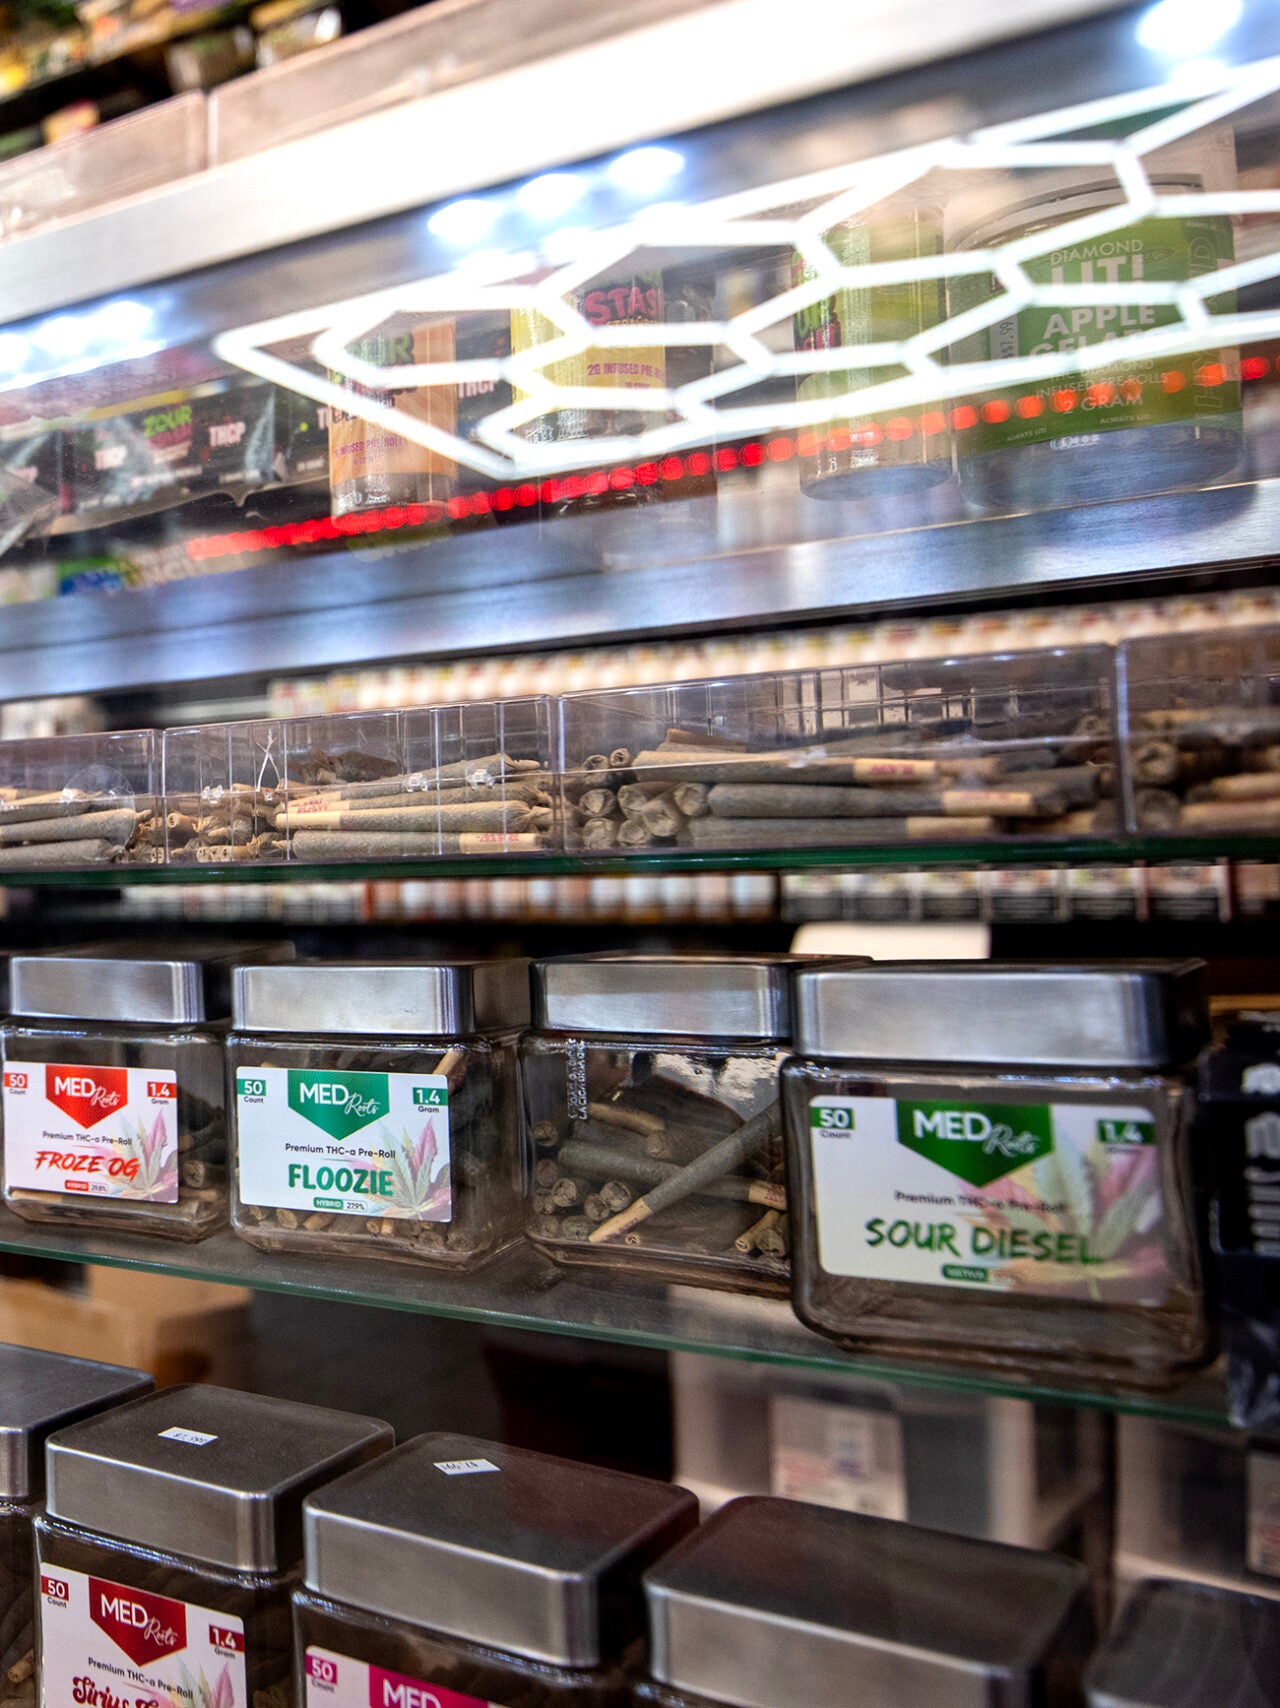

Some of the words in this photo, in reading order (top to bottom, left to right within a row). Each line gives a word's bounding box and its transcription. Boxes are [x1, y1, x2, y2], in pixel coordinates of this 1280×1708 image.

[1050, 239, 1144, 266] DIAMOND
[1043, 304, 1155, 339] APPLE
[1081, 392, 1143, 411] GRAM
[9, 1074, 25, 1087] 50
[149, 1083, 170, 1097] 1.4
[243, 1080, 263, 1095] 50
[55, 1076, 96, 1098] MED
[91, 1086, 122, 1108] Roots
[243, 1096, 264, 1104] Count
[300, 1083, 350, 1106] MED
[344, 1093, 381, 1117] Roots
[416, 1089, 440, 1105] 1.4
[418, 1105, 440, 1114] Gram
[820, 1109, 849, 1128] 50
[42, 1131, 74, 1141] Premium
[76, 1134, 100, 1143] THC-a
[102, 1136, 132, 1145] Pre-Roll
[820, 1130, 852, 1140] Count
[913, 1109, 992, 1141] MED
[985, 1125, 1041, 1158] Roots
[285, 1143, 324, 1154] Premium
[326, 1146, 356, 1156] THC-a
[358, 1148, 396, 1159] Pre-Roll
[35, 1151, 104, 1174] FROZE
[108, 1157, 141, 1182] OG
[288, 1163, 393, 1197] FLOOZIE
[894, 1189, 956, 1207] Premium
[865, 1217, 961, 1258] SOUR
[972, 1226, 1105, 1264] DIESEL
[47, 1579, 66, 1599] 50
[47, 1596, 68, 1609] Count
[101, 1594, 149, 1628] MED
[144, 1616, 178, 1647] Roots
[212, 1628, 236, 1649] 1.4
[214, 1647, 236, 1659] Gram
[88, 1657, 126, 1677] Premium
[127, 1669, 156, 1687] THC-a
[157, 1679, 194, 1700] Pre-Roll
[311, 1660, 334, 1681] 50
